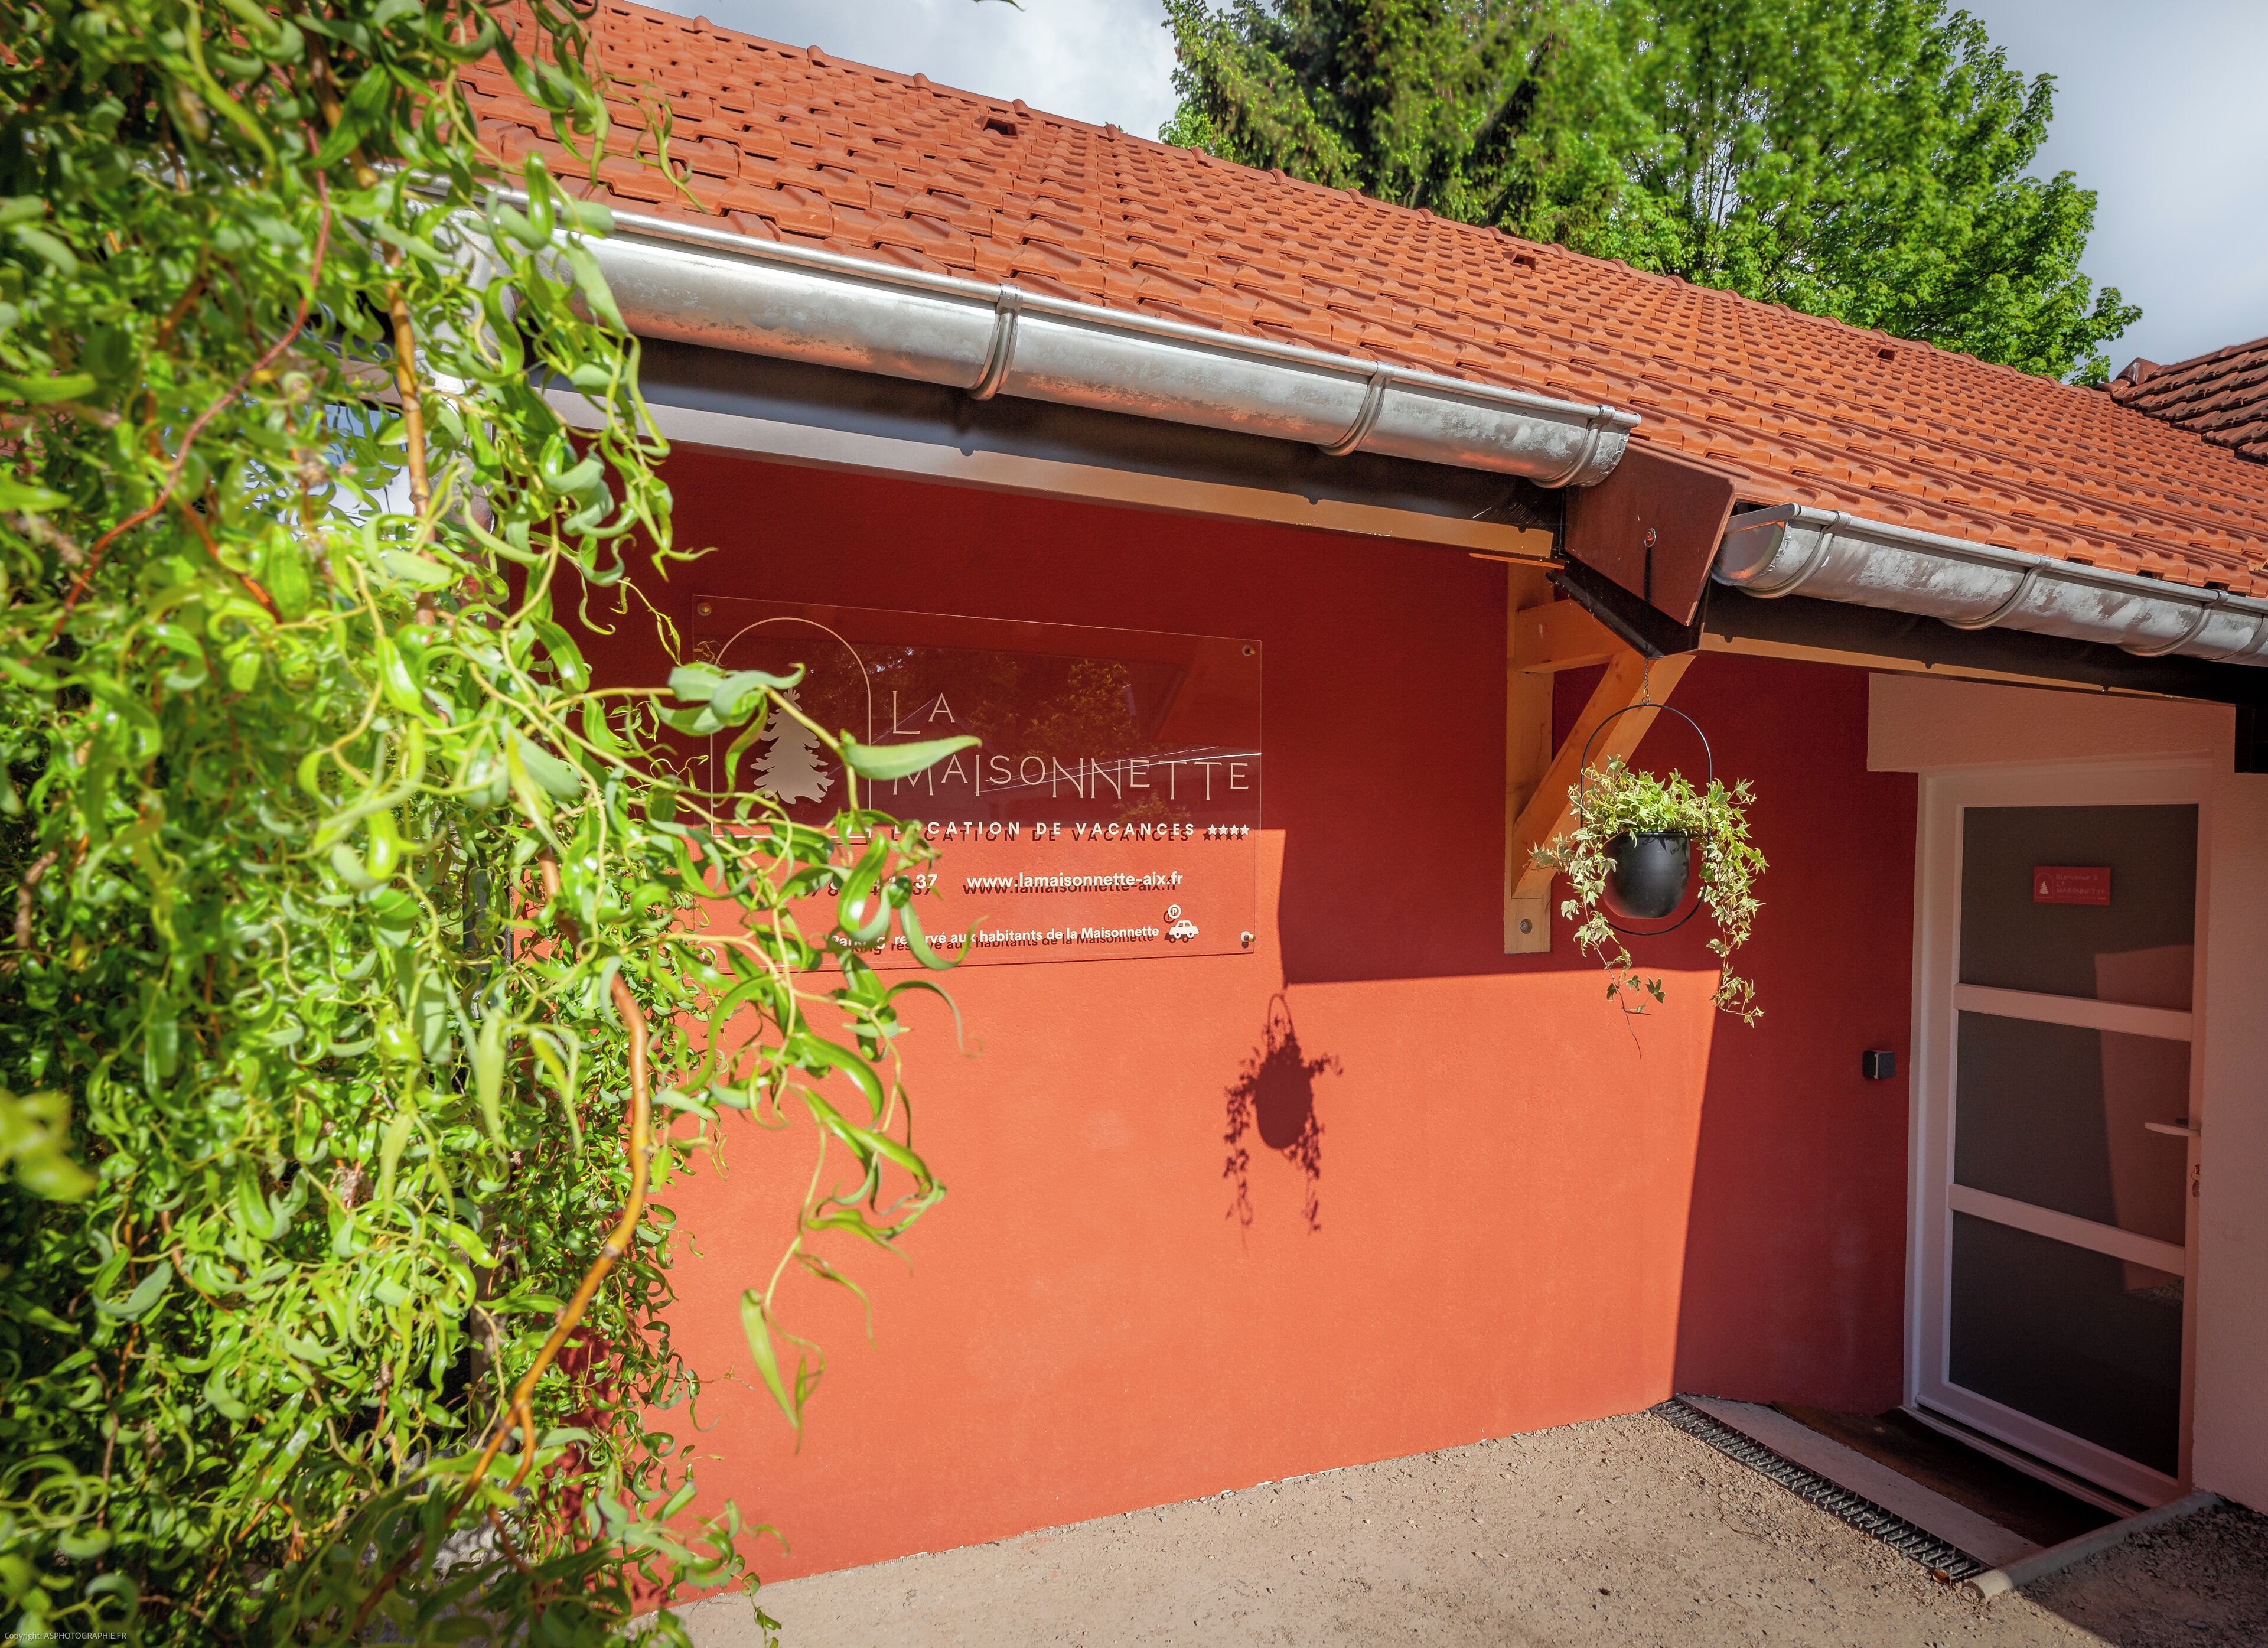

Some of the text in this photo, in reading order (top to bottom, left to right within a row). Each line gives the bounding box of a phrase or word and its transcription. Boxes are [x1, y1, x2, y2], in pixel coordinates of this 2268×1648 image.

[892, 690, 956, 734] LA
[894, 821, 1194, 836] LCATION DE VACANCES
[966, 871, 1183, 888] www.lamaisonnette-aix.fr
[894, 932, 947, 945] rervé
[950, 933, 976, 943] aux
[979, 929, 1042, 943] habitants
[1047, 929, 1063, 940] de
[1066, 927, 1080, 939] la
[1081, 926, 1159, 939] Maisonnette
